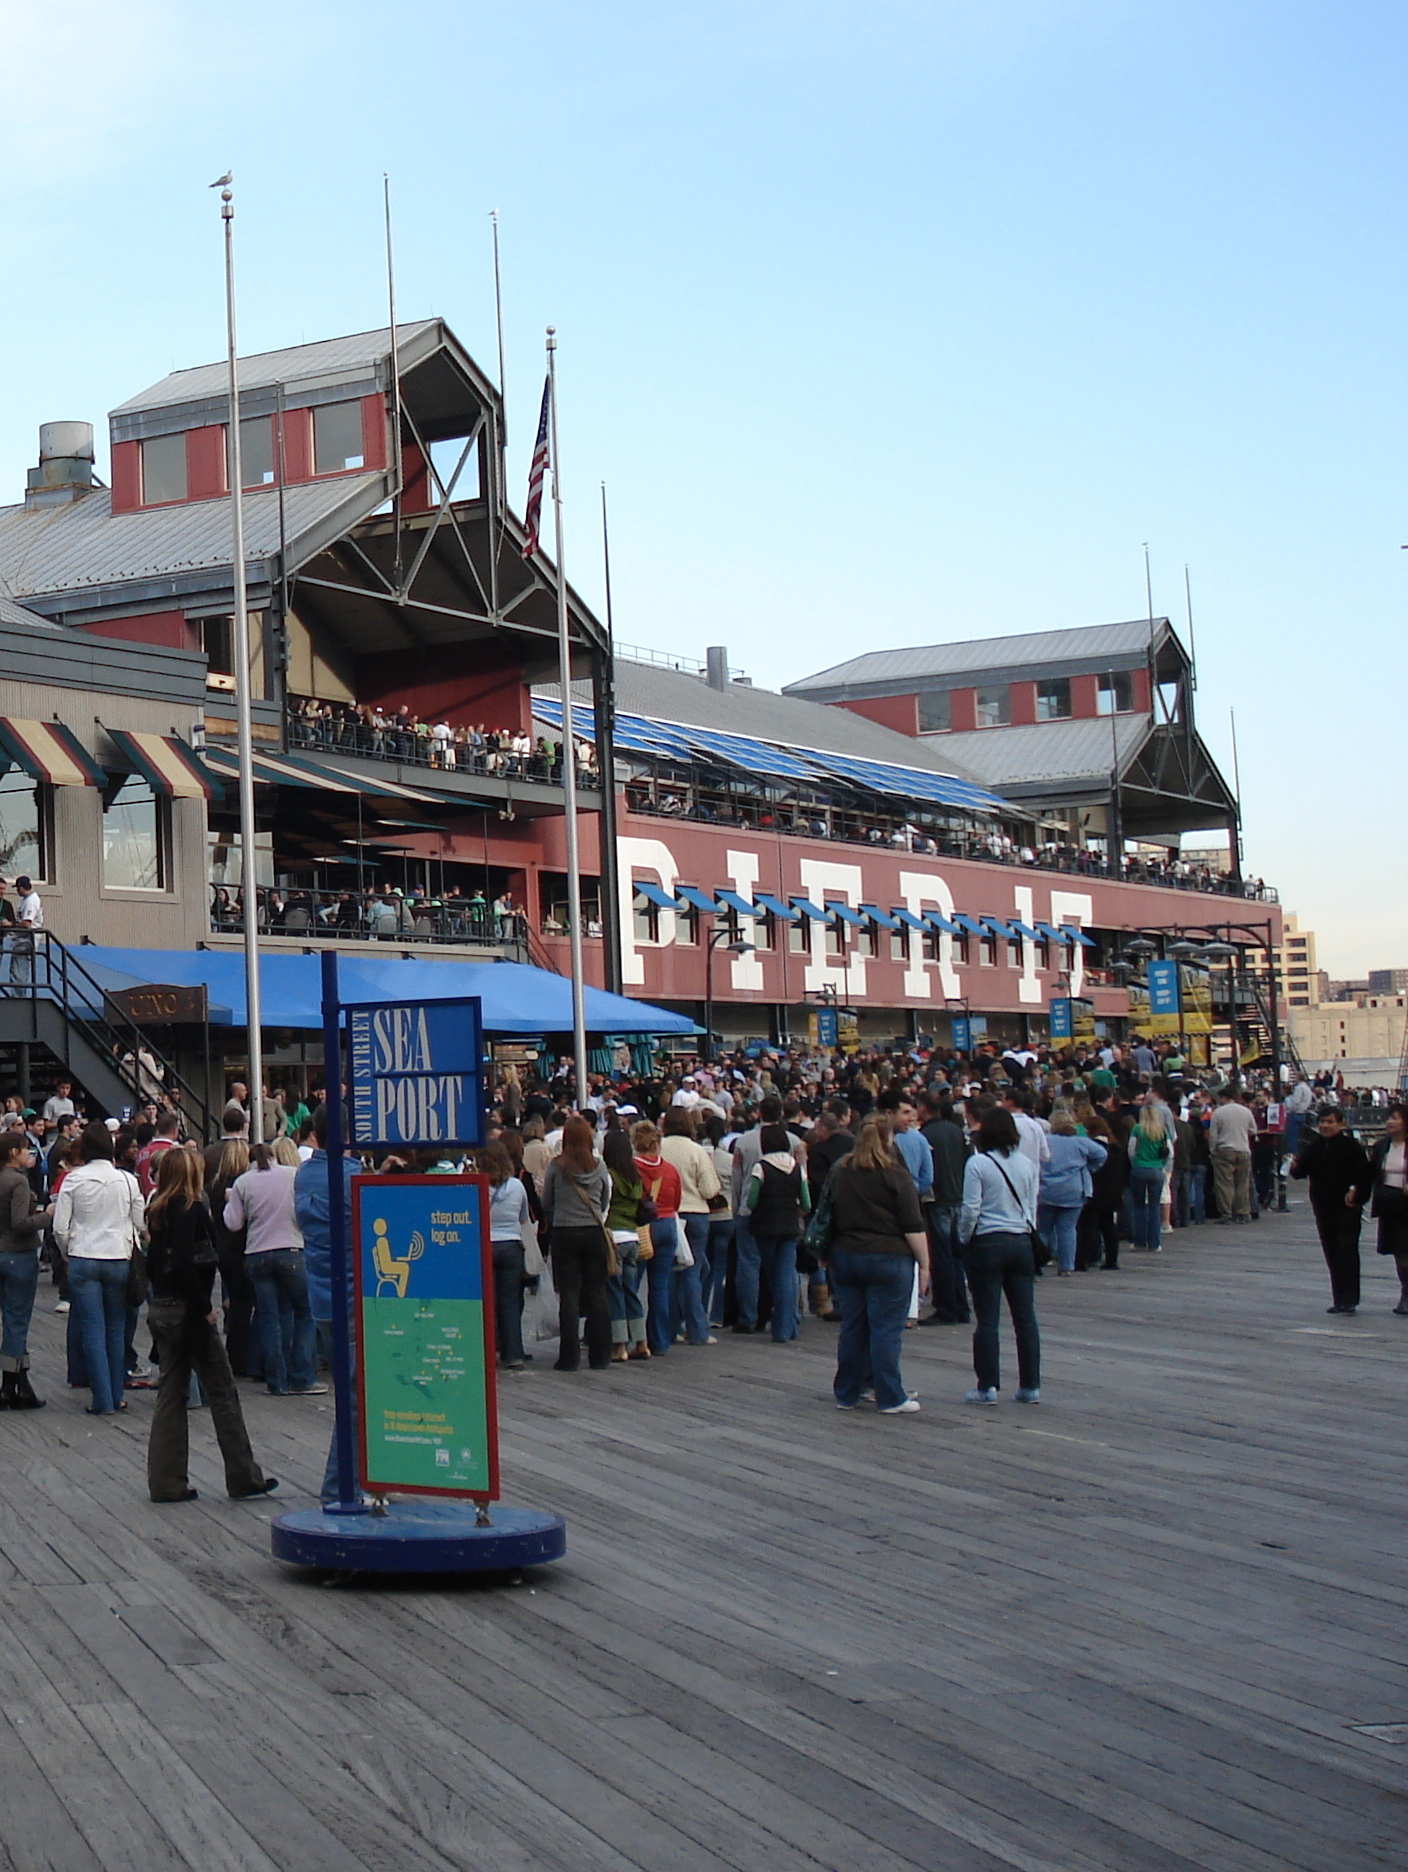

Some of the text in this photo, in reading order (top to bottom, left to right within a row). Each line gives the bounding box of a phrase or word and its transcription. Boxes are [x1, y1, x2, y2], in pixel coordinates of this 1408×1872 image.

[616, 836, 1093, 1003] PIER 17
[373, 1006, 433, 1073] SEA
[352, 1011, 373, 1142] SOUTH STREET
[376, 1075, 462, 1142] PORT
[430, 1210, 452, 1227] step
[431, 1228, 445, 1246] log
